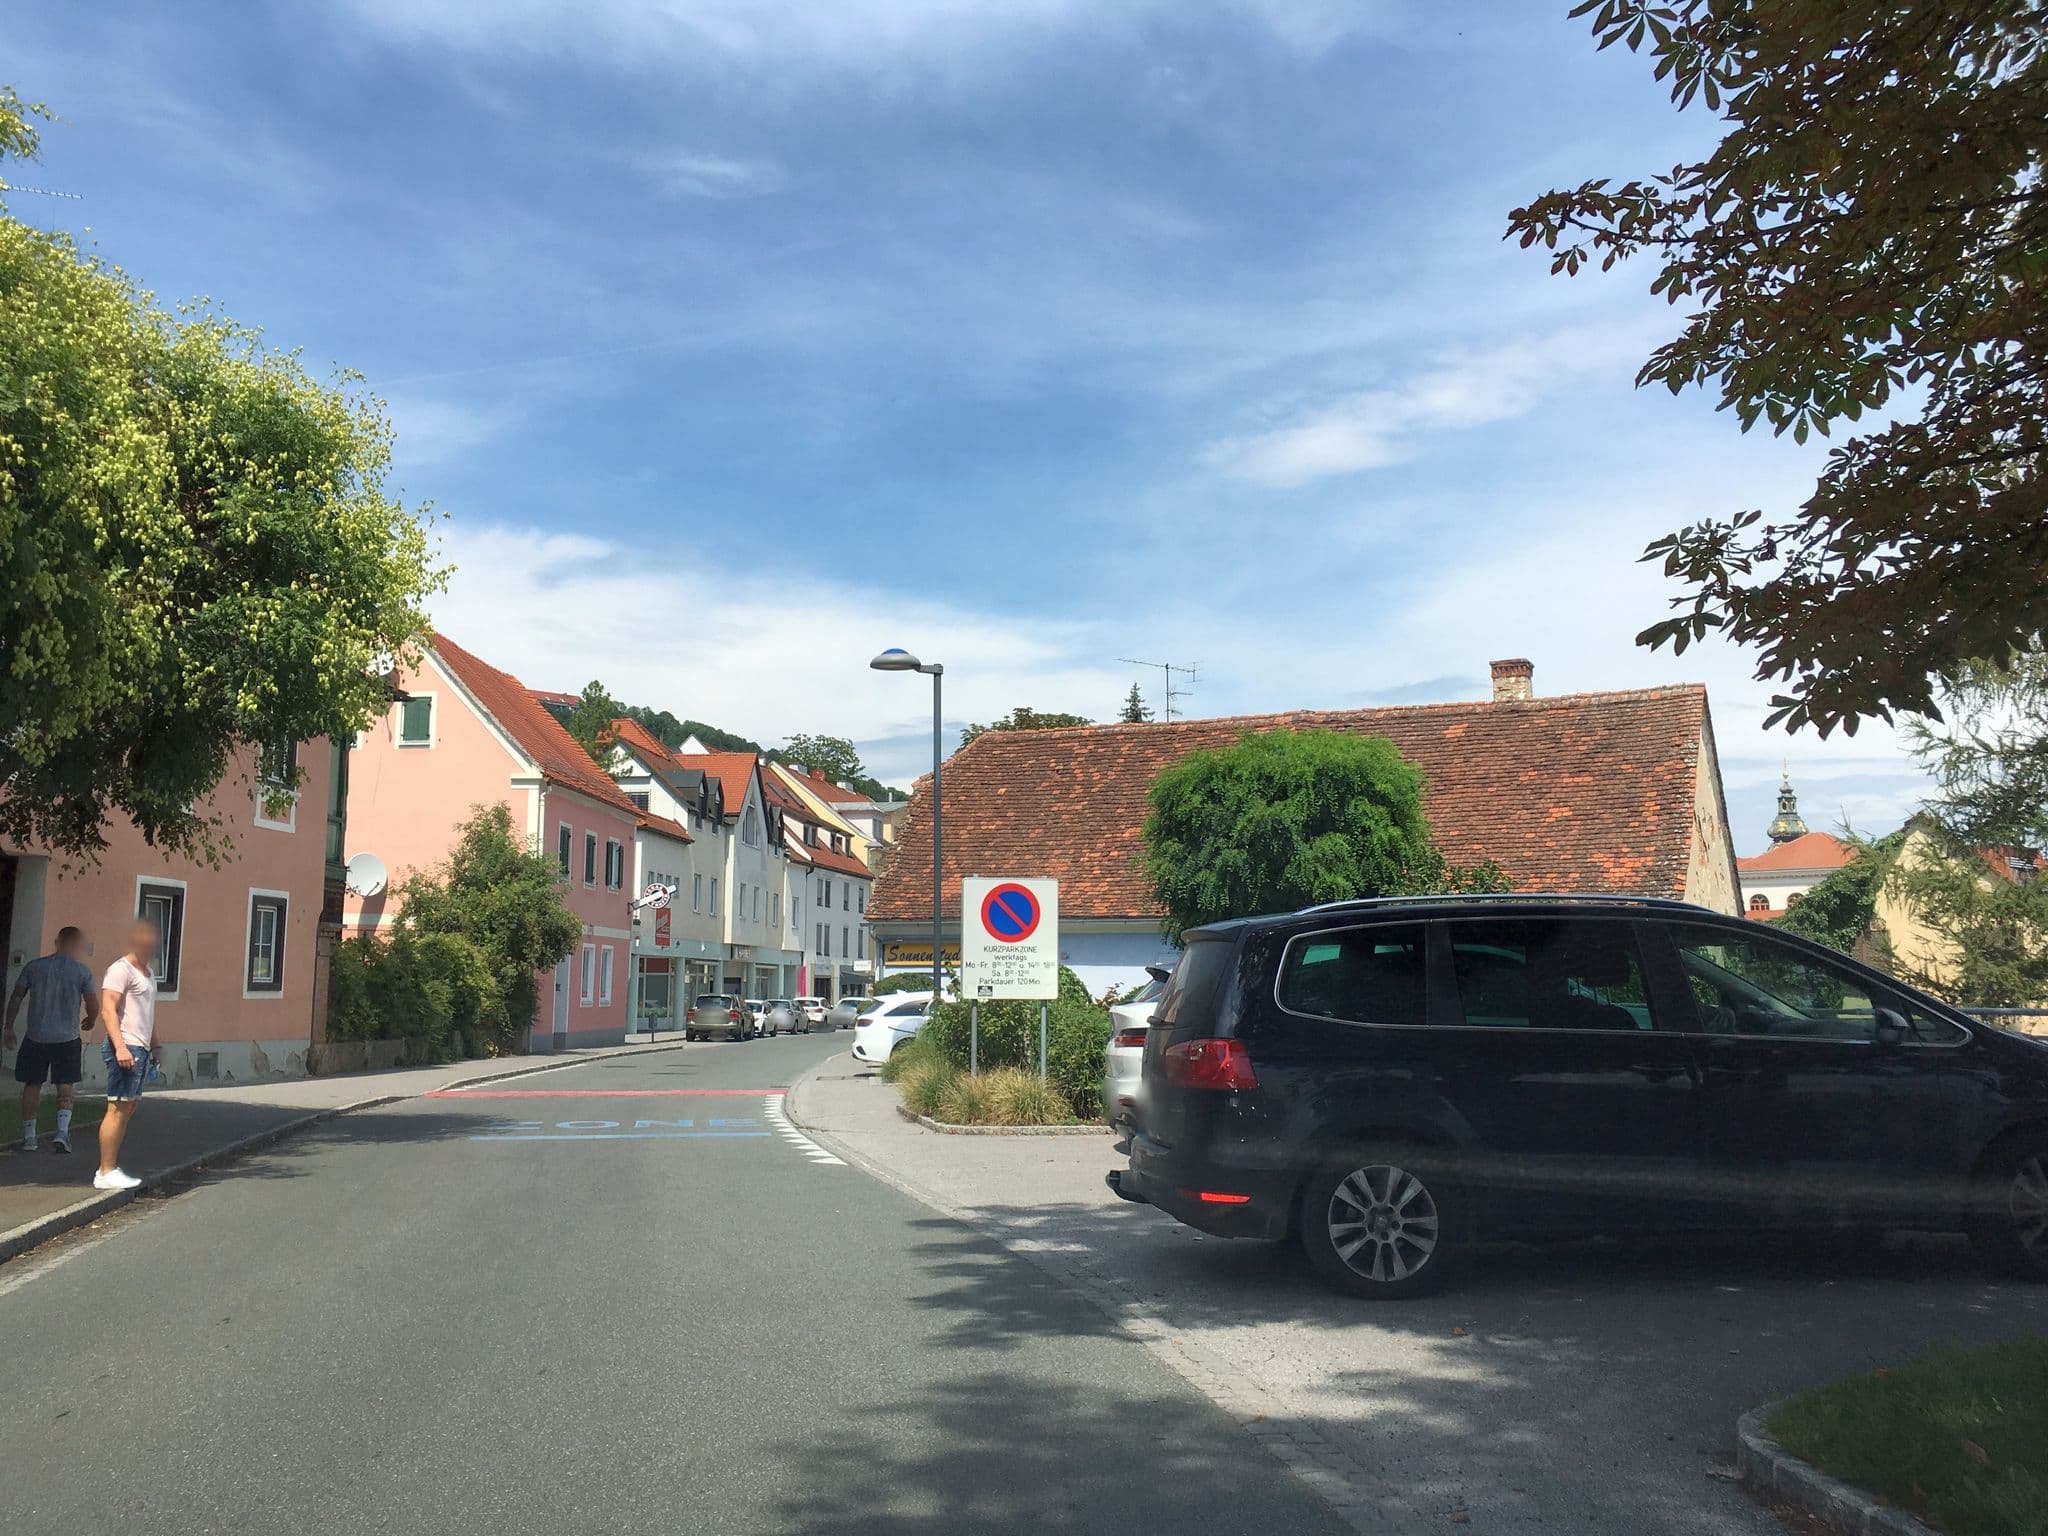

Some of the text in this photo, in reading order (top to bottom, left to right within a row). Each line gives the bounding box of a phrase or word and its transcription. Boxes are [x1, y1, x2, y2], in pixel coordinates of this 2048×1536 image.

[983, 945, 1038, 953] KURZPARKZONE
[993, 953, 1028, 961] werktags
[1017, 977, 1028, 985] 120
[482, 1118, 762, 1130] ZONE
